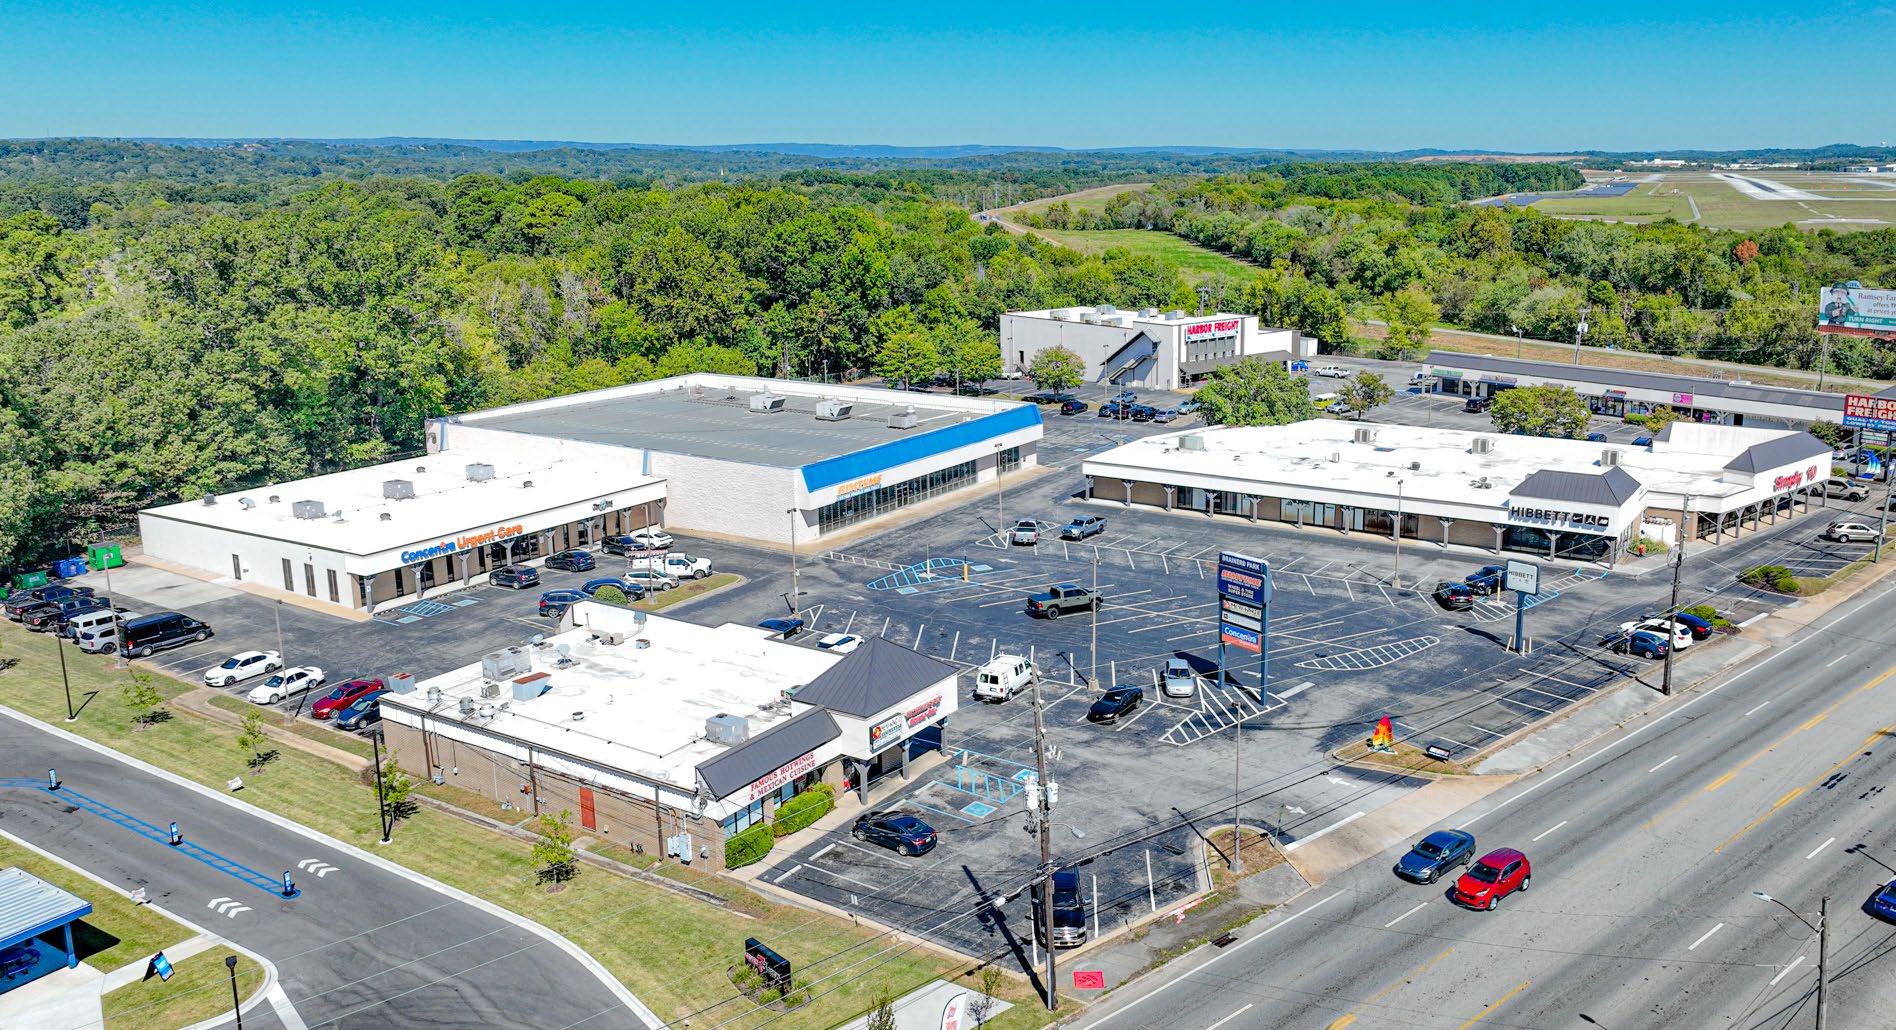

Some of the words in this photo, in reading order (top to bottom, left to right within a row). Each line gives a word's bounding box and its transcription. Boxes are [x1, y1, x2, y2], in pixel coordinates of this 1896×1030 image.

[1187, 323, 1212, 335] HARBOR
[1214, 320, 1239, 332] FREIGHT
[1511, 506, 1571, 521] HIBBETT
[401, 541, 456, 564] Concentra
[457, 529, 494, 549] Urgent
[497, 524, 523, 539] Care
[1247, 561, 1260, 571] PARK
[1508, 570, 1534, 580] HIBBETT
[750, 771, 778, 792] FAMOUS
[780, 752, 815, 775] HOTWINGS
[749, 793, 755, 801] &
[757, 774, 787, 797] MEXICAN
[789, 760, 816, 779] CUISINE
